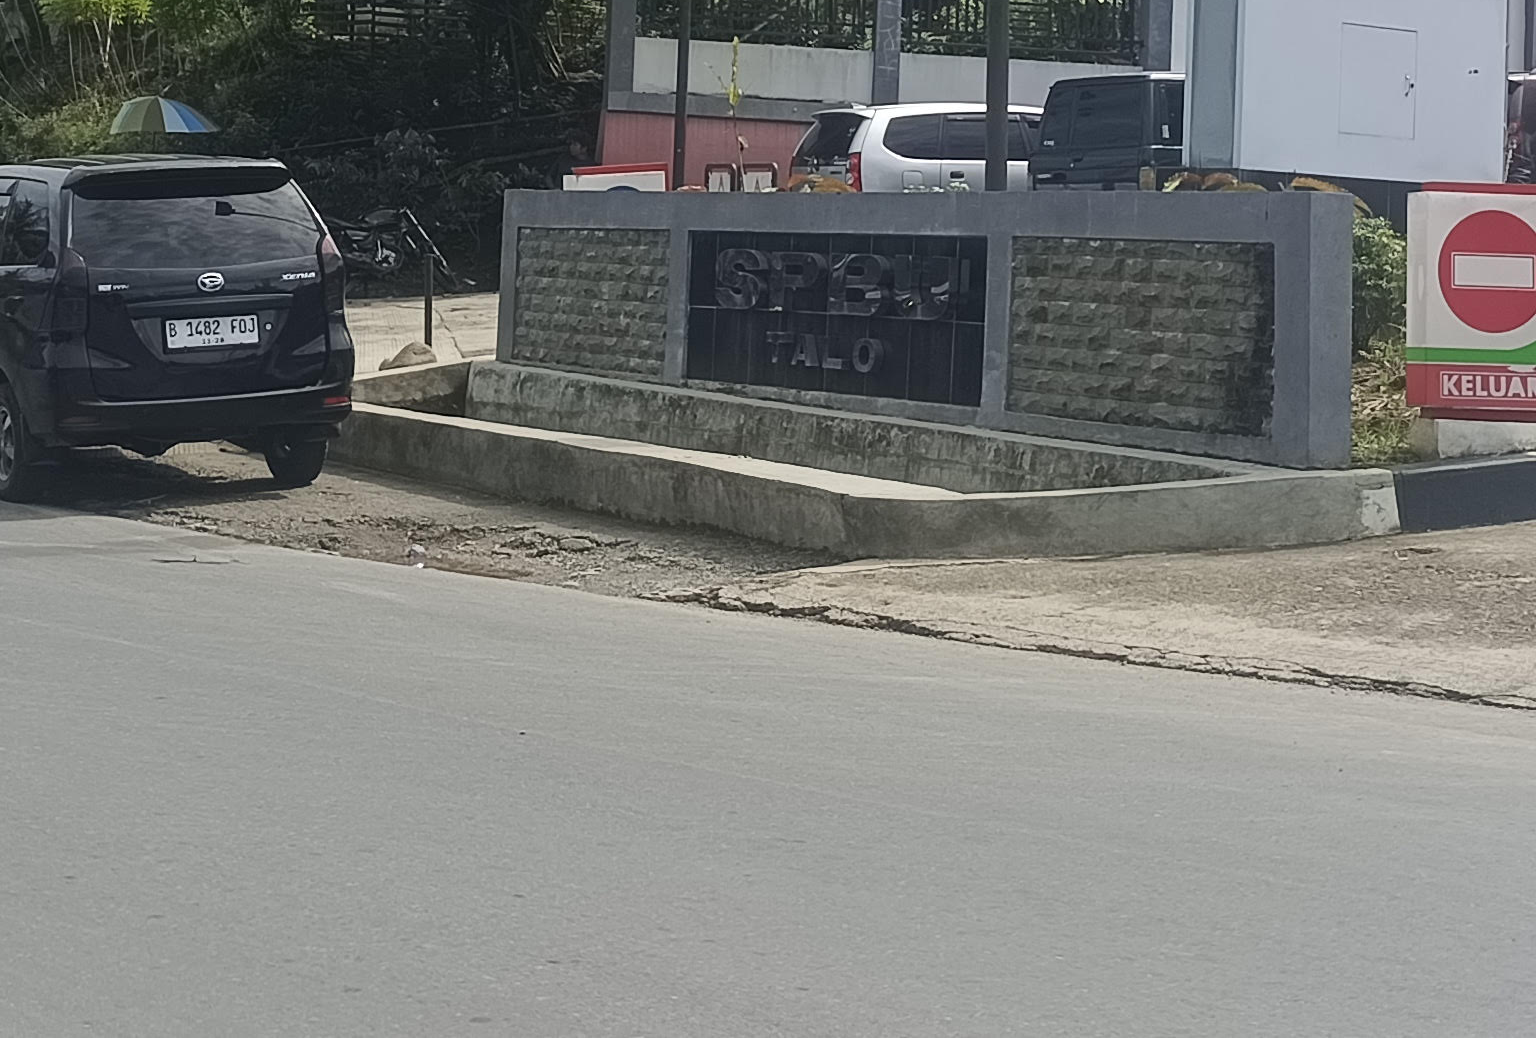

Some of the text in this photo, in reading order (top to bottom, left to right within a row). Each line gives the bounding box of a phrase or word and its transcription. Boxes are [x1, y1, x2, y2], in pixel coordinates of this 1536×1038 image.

[713, 247, 956, 322] SPBU
[168, 322, 177, 338] B
[186, 319, 221, 337] 1482
[766, 330, 882, 374] TALO
